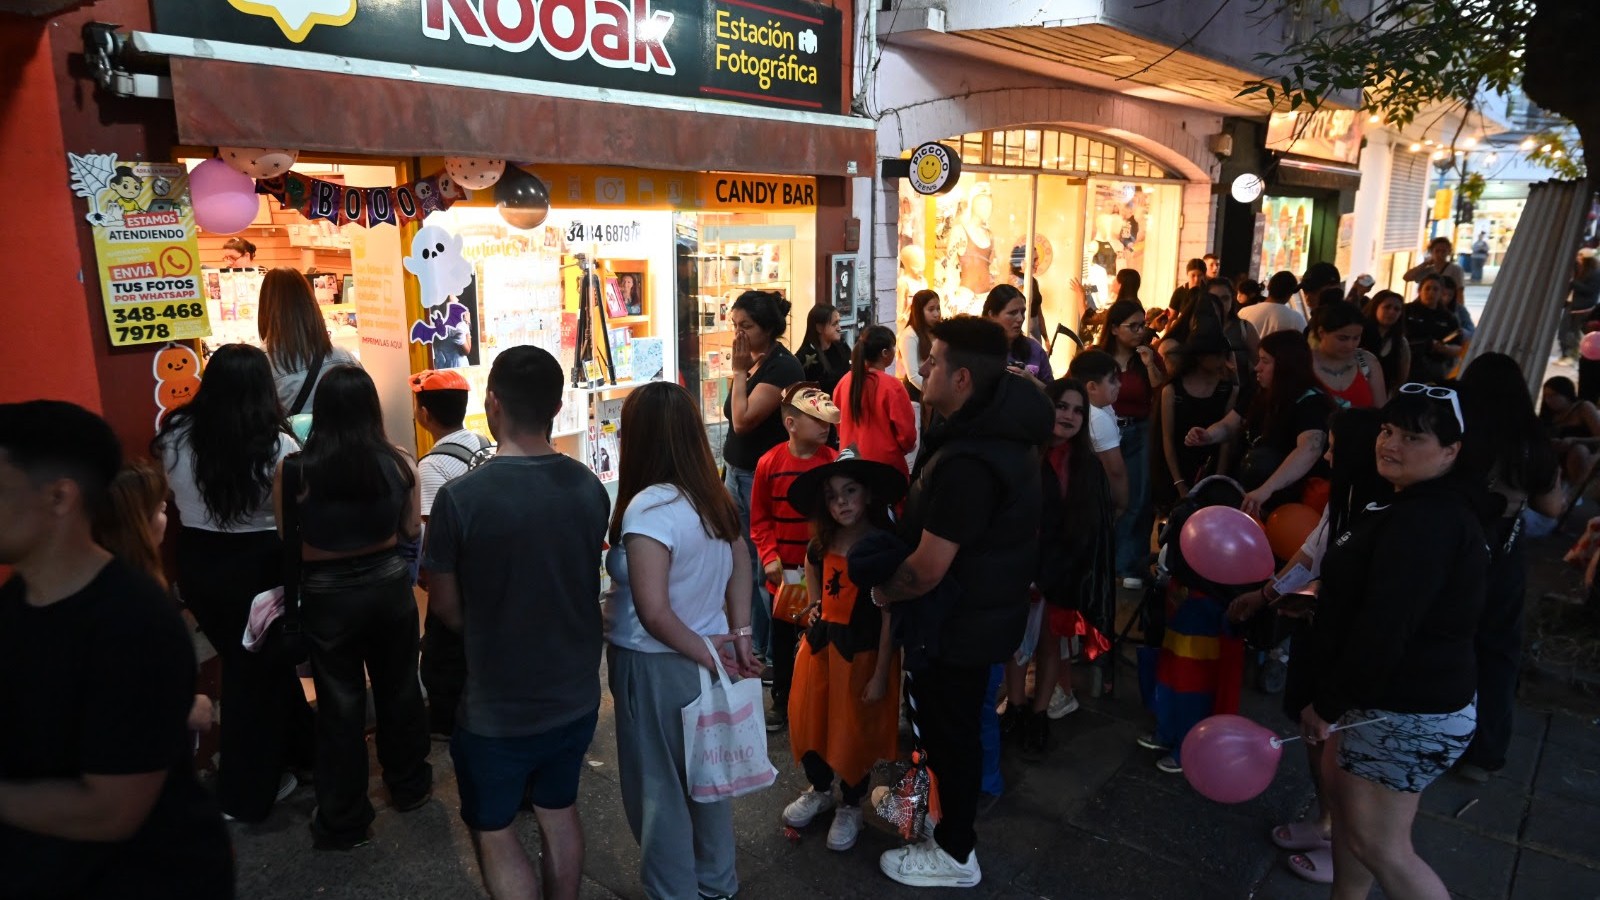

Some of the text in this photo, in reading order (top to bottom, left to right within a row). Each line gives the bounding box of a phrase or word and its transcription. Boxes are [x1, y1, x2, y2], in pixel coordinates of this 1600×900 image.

[715, 9, 795, 51] Estación
[715, 43, 818, 90] Fotográfica
[913, 146, 949, 172] PICCOLO
[715, 179, 814, 206] CANDY BAR
[915, 180, 938, 191] TEENS
[126, 213, 176, 227] ESTAMOS
[109, 229, 184, 241] ATENDIENDO
[113, 263, 155, 280] ENVIÁ
[113, 279, 194, 293] TUS FOTOS
[114, 290, 195, 303] POR WHATSAPP
[113, 302, 204, 324] 348-468
[116, 323, 170, 342] 7978
